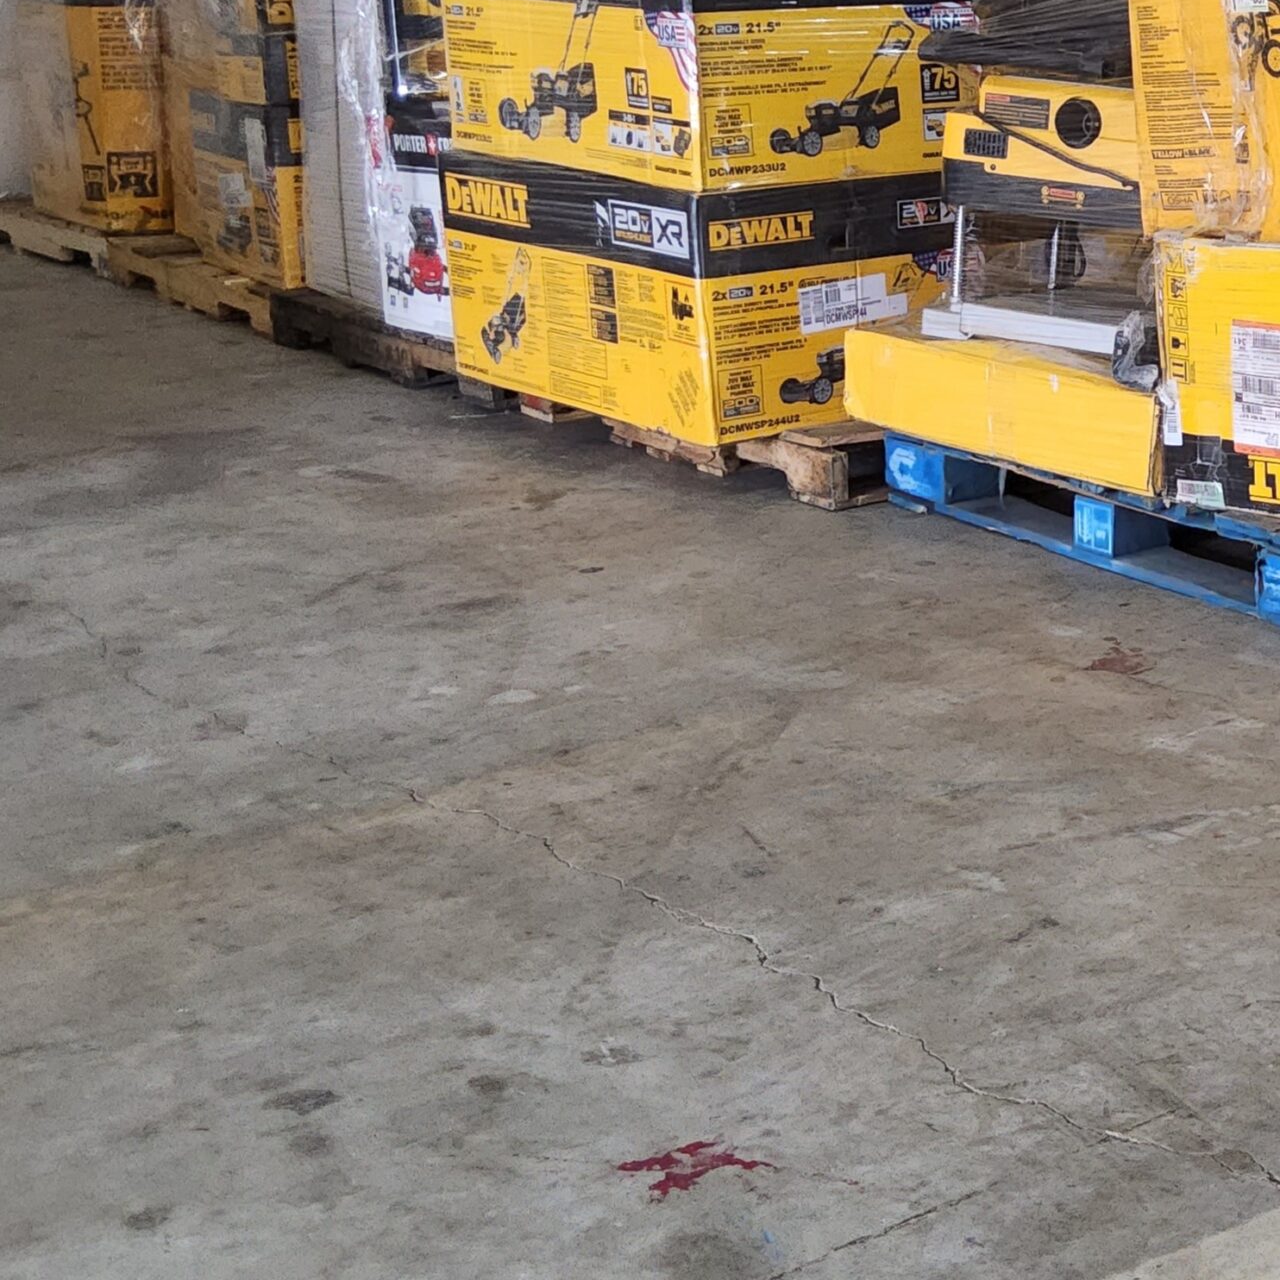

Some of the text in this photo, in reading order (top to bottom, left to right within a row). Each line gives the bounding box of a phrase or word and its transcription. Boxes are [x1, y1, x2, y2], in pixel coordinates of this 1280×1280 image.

[658, 25, 676, 41] USA
[932, 14, 961, 30] USA
[631, 73, 647, 96] 75
[931, 66, 956, 89] 75
[394, 134, 426, 152] PORTER
[444, 178, 529, 224] DEWALT
[656, 216, 684, 248] XR
[709, 214, 814, 249] DEWALT
[712, 290, 727, 301] 2x
